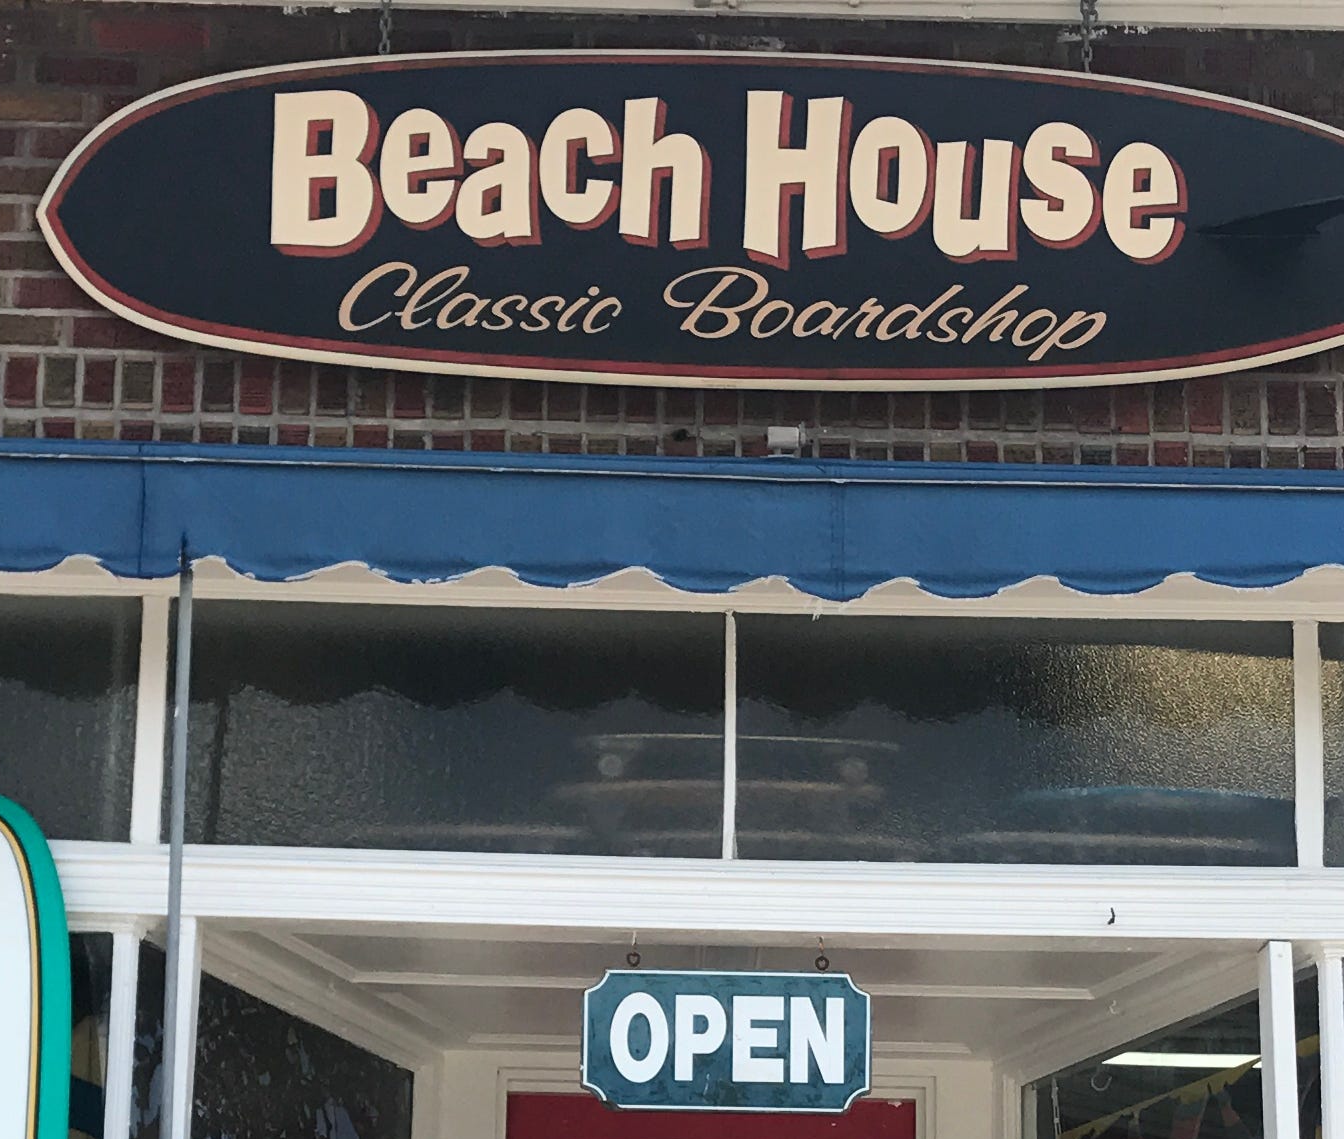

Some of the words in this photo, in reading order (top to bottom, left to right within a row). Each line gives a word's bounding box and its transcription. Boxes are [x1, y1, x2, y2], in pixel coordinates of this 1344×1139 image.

[269, 88, 718, 261] Beach
[742, 88, 1188, 270] House
[337, 261, 622, 336] Classic
[662, 265, 1108, 363] Boardshop
[609, 991, 845, 1085] OPEN
